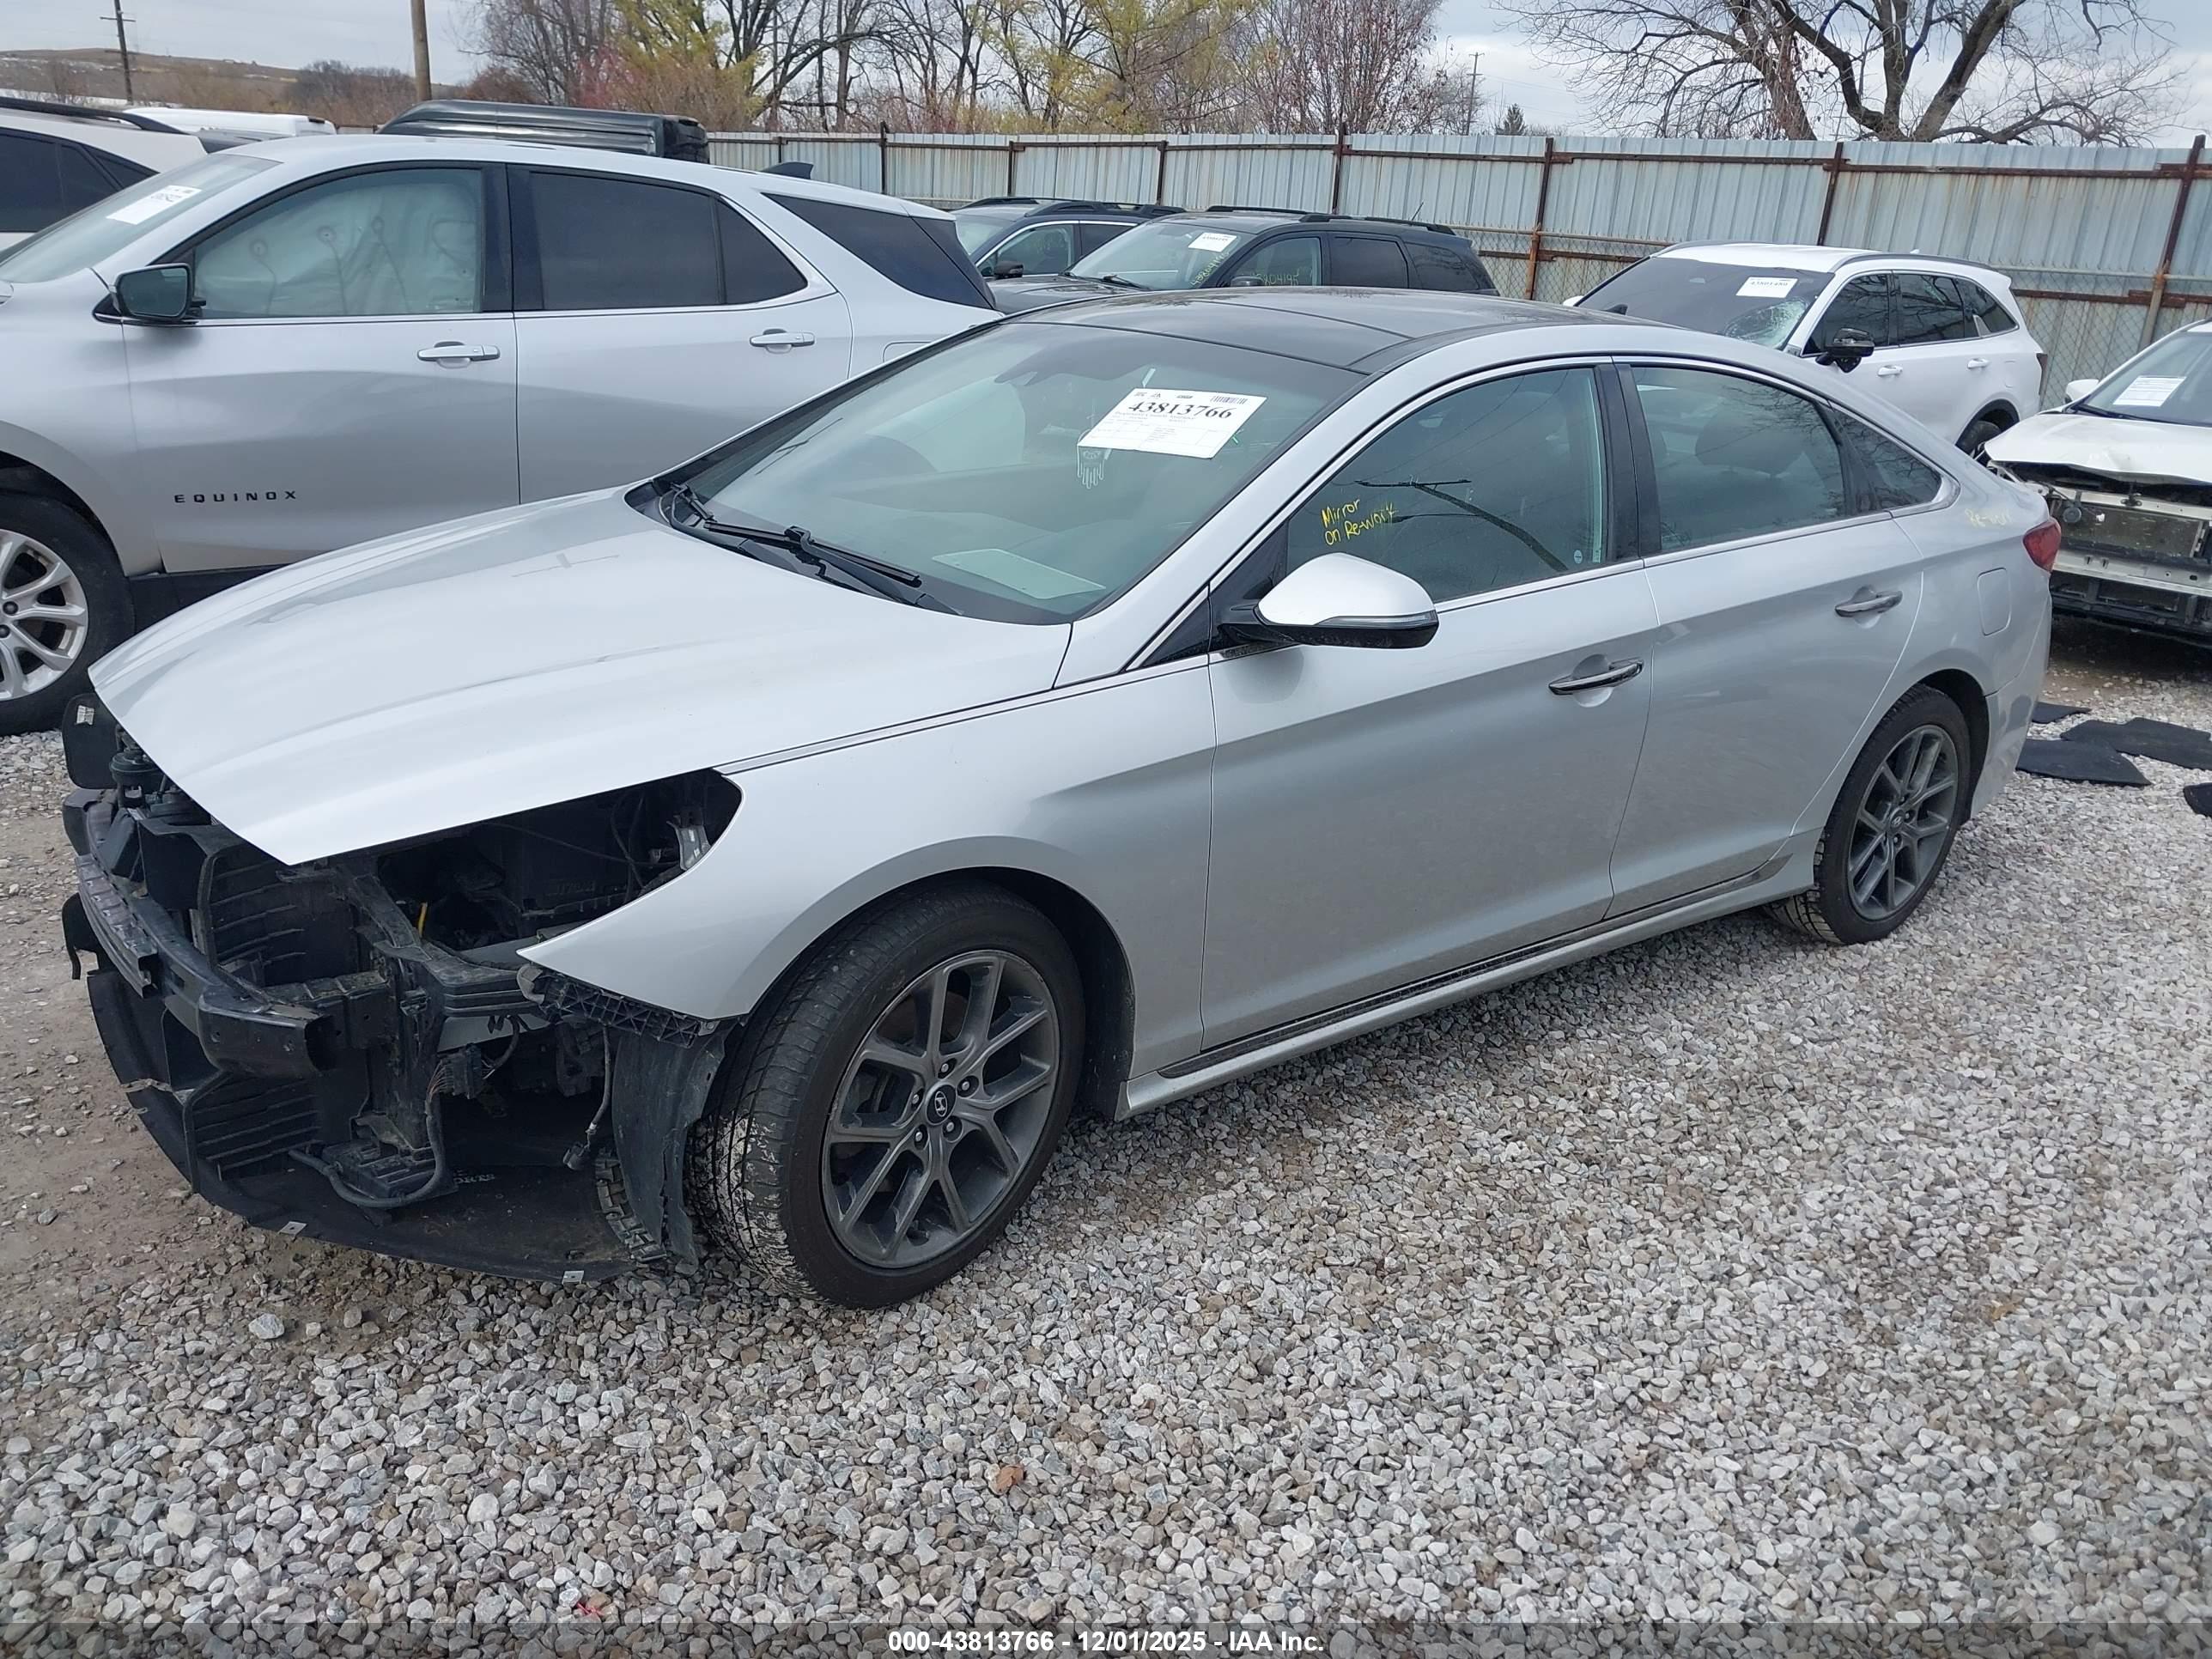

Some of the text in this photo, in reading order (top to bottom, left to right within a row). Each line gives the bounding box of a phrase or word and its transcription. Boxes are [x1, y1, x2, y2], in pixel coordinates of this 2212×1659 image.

[1128, 400, 1237, 419] 43813766
[174, 490, 296, 503] EQUINOX
[1322, 498, 1361, 528] Mirror
